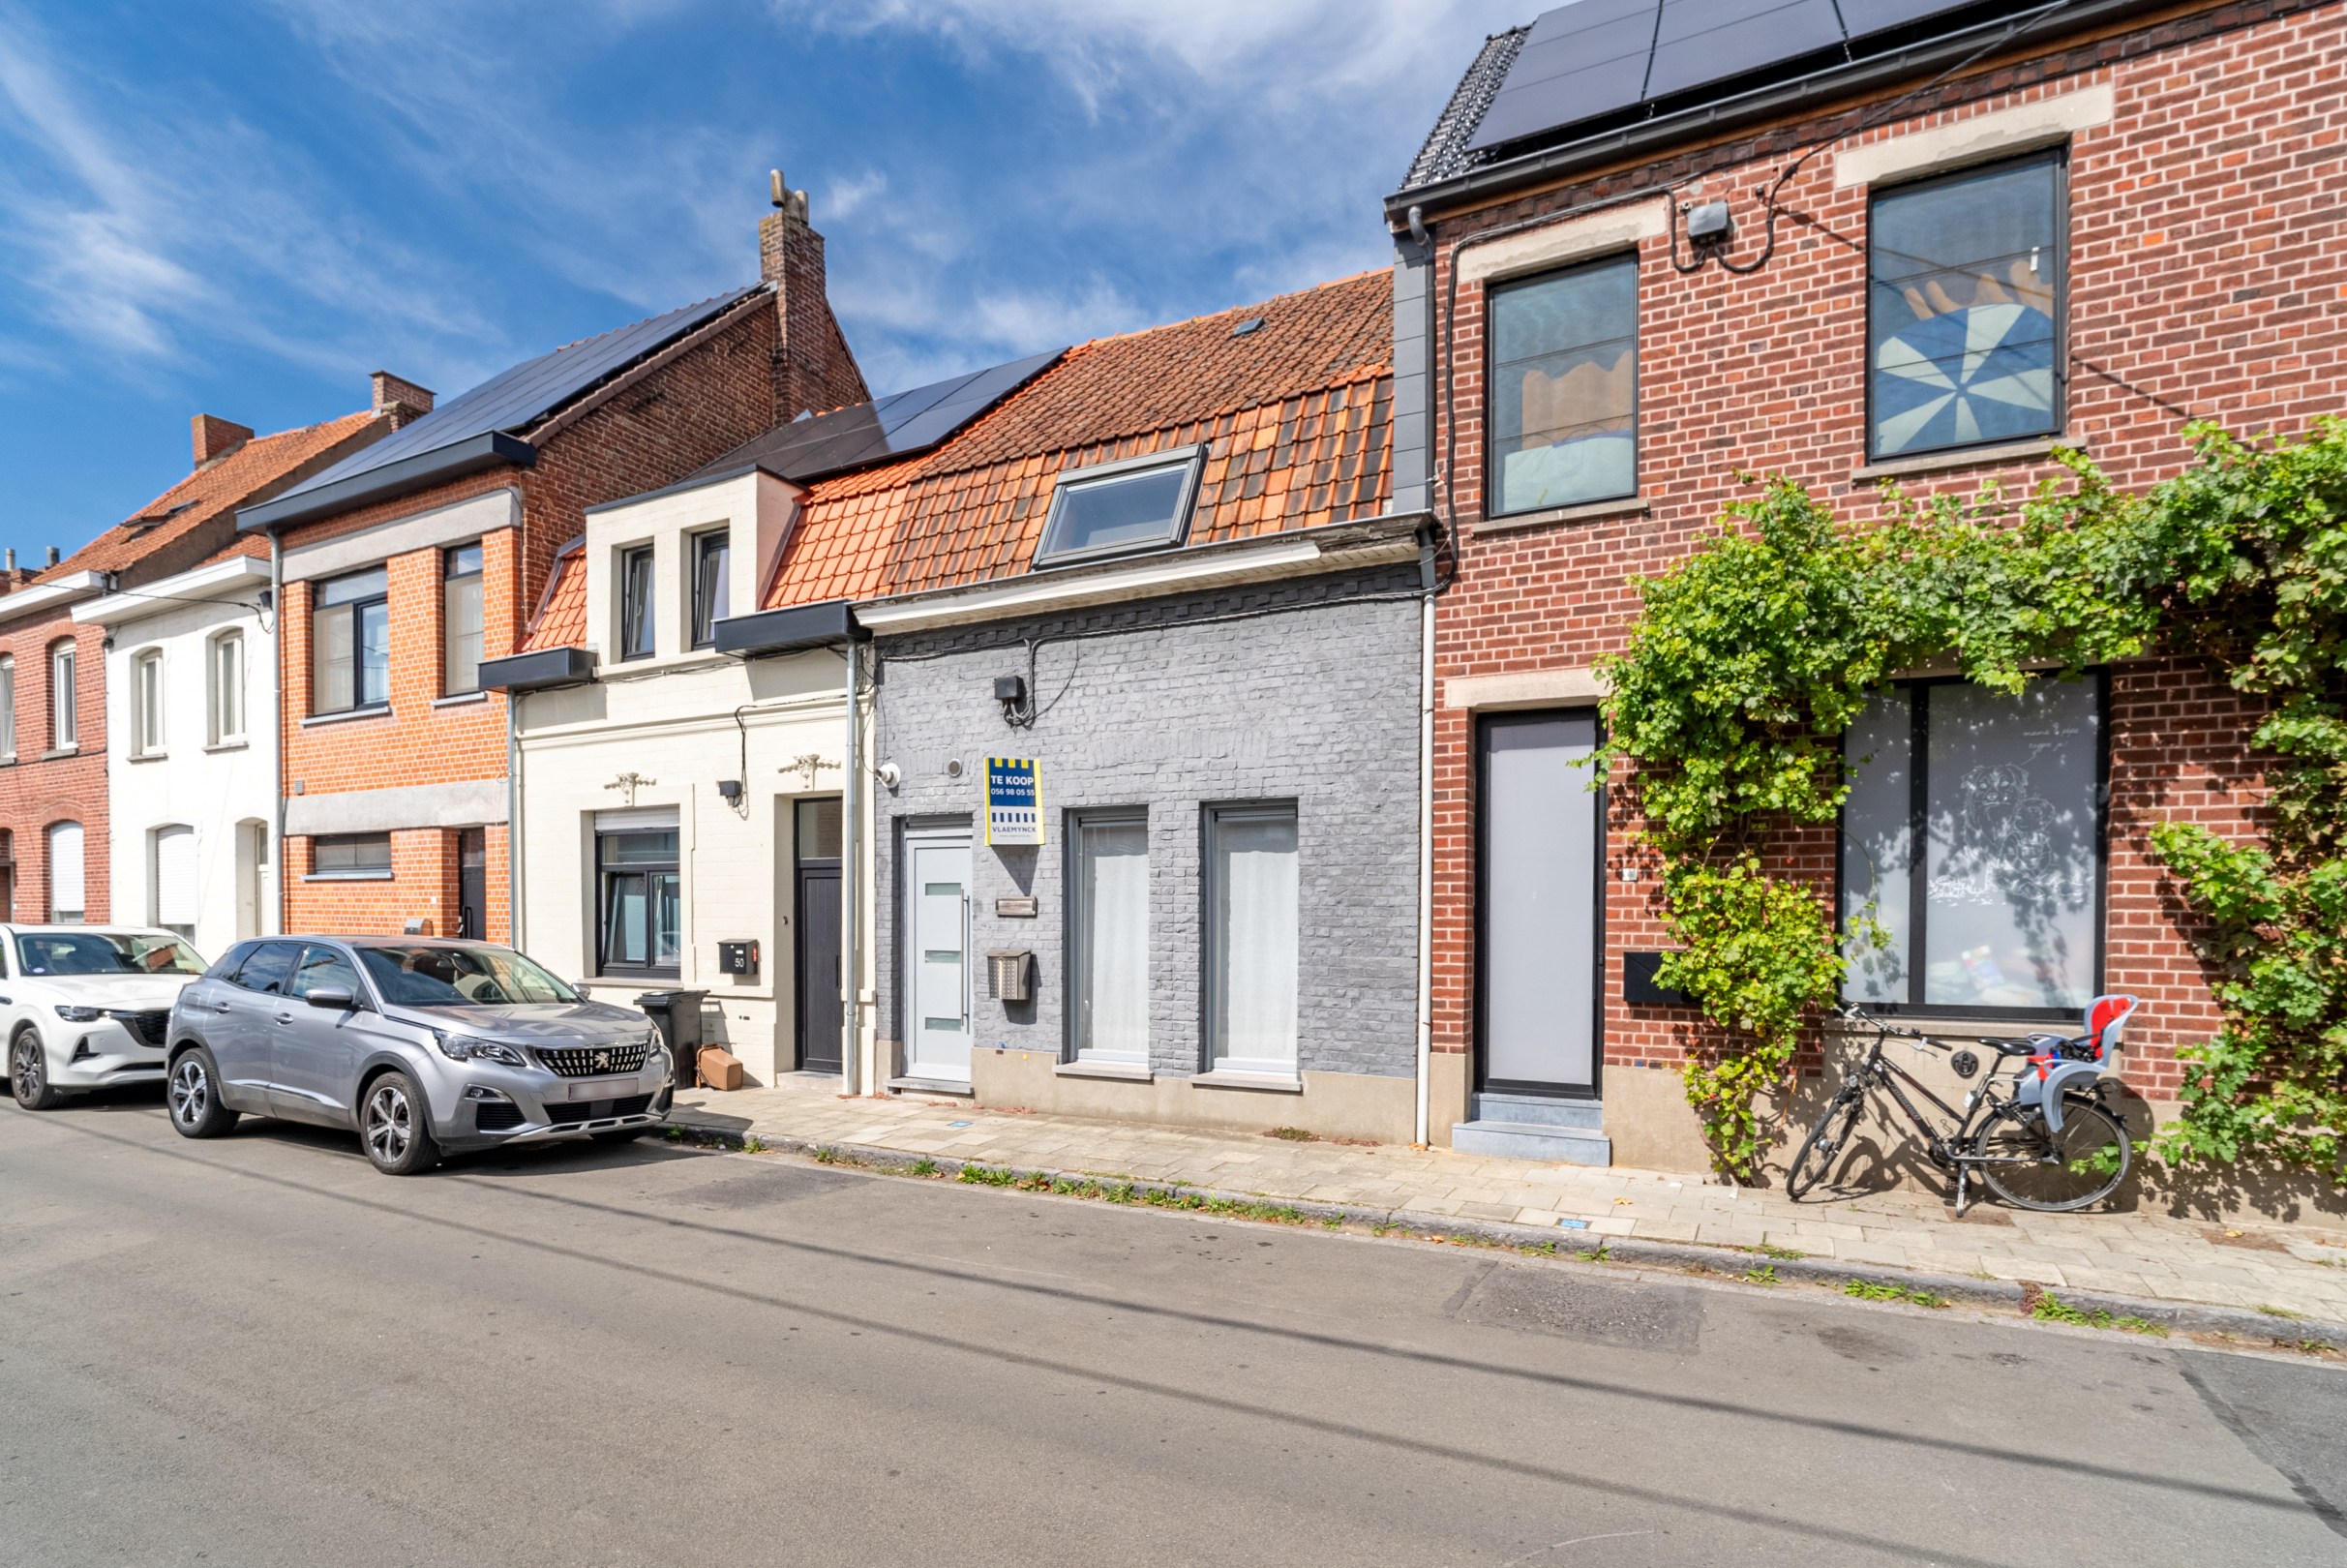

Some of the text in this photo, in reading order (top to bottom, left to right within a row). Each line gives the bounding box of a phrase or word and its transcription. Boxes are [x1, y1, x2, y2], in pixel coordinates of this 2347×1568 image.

[990, 775, 1034, 786] TE KOOP
[1016, 788, 1026, 797] 05
[735, 957, 744, 968] 50
